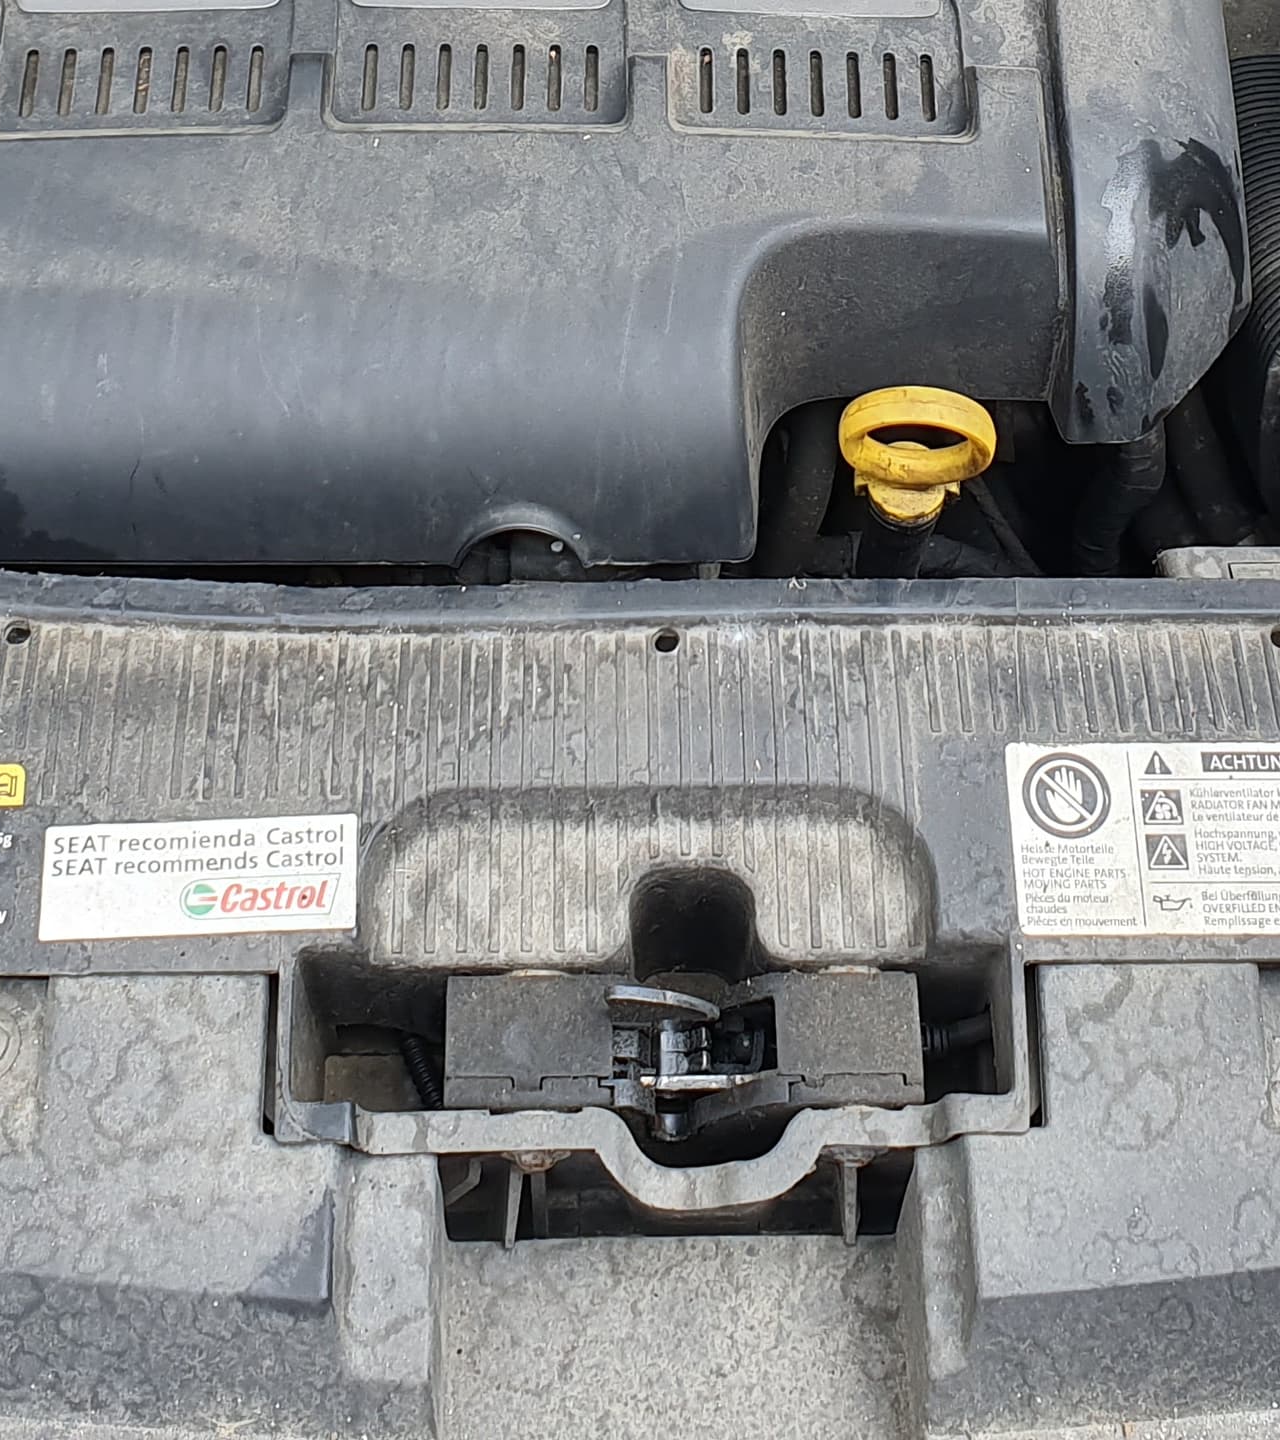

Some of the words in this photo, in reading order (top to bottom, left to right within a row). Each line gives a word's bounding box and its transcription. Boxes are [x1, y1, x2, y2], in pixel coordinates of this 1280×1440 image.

[1189, 788, 1274, 798] Kühlerventilator
[1191, 800, 1244, 810] RADIATOR
[1247, 800, 1268, 810] FAN
[1192, 812, 1204, 822] Le
[1206, 812, 1263, 822] ventilateur
[1266, 812, 1279, 822] de
[53, 835, 110, 855] SEAT
[119, 829, 256, 852] recomienda
[266, 824, 344, 845] Castrol
[1196, 840, 1224, 850] HIGH
[51, 858, 107, 877] SEAT
[114, 851, 258, 875] recommends
[266, 847, 344, 867] Castrol
[1022, 855, 1068, 866] Bewegte
[1071, 855, 1094, 864] Teile
[1197, 852, 1242, 862] SYSTEM.
[1023, 869, 1045, 878] HOT
[1049, 869, 1090, 878] ENGINE
[1094, 869, 1126, 878] PARTS
[1198, 865, 1231, 875] Haute
[1024, 879, 1070, 890] MOVING
[1074, 879, 1107, 889] PARTS
[220, 880, 328, 913] Castrol
[1025, 893, 1055, 903] Pièces
[1058, 893, 1070, 903] du
[1201, 891, 1218, 901] Bei
[1026, 905, 1068, 913] chaudes
[1203, 903, 1266, 912] OVERFILLED
[1027, 916, 1058, 926] Pièces
[1060, 916, 1072, 926] en
[1075, 916, 1138, 926] mouvement
[1204, 916, 1271, 928] Remplissage
